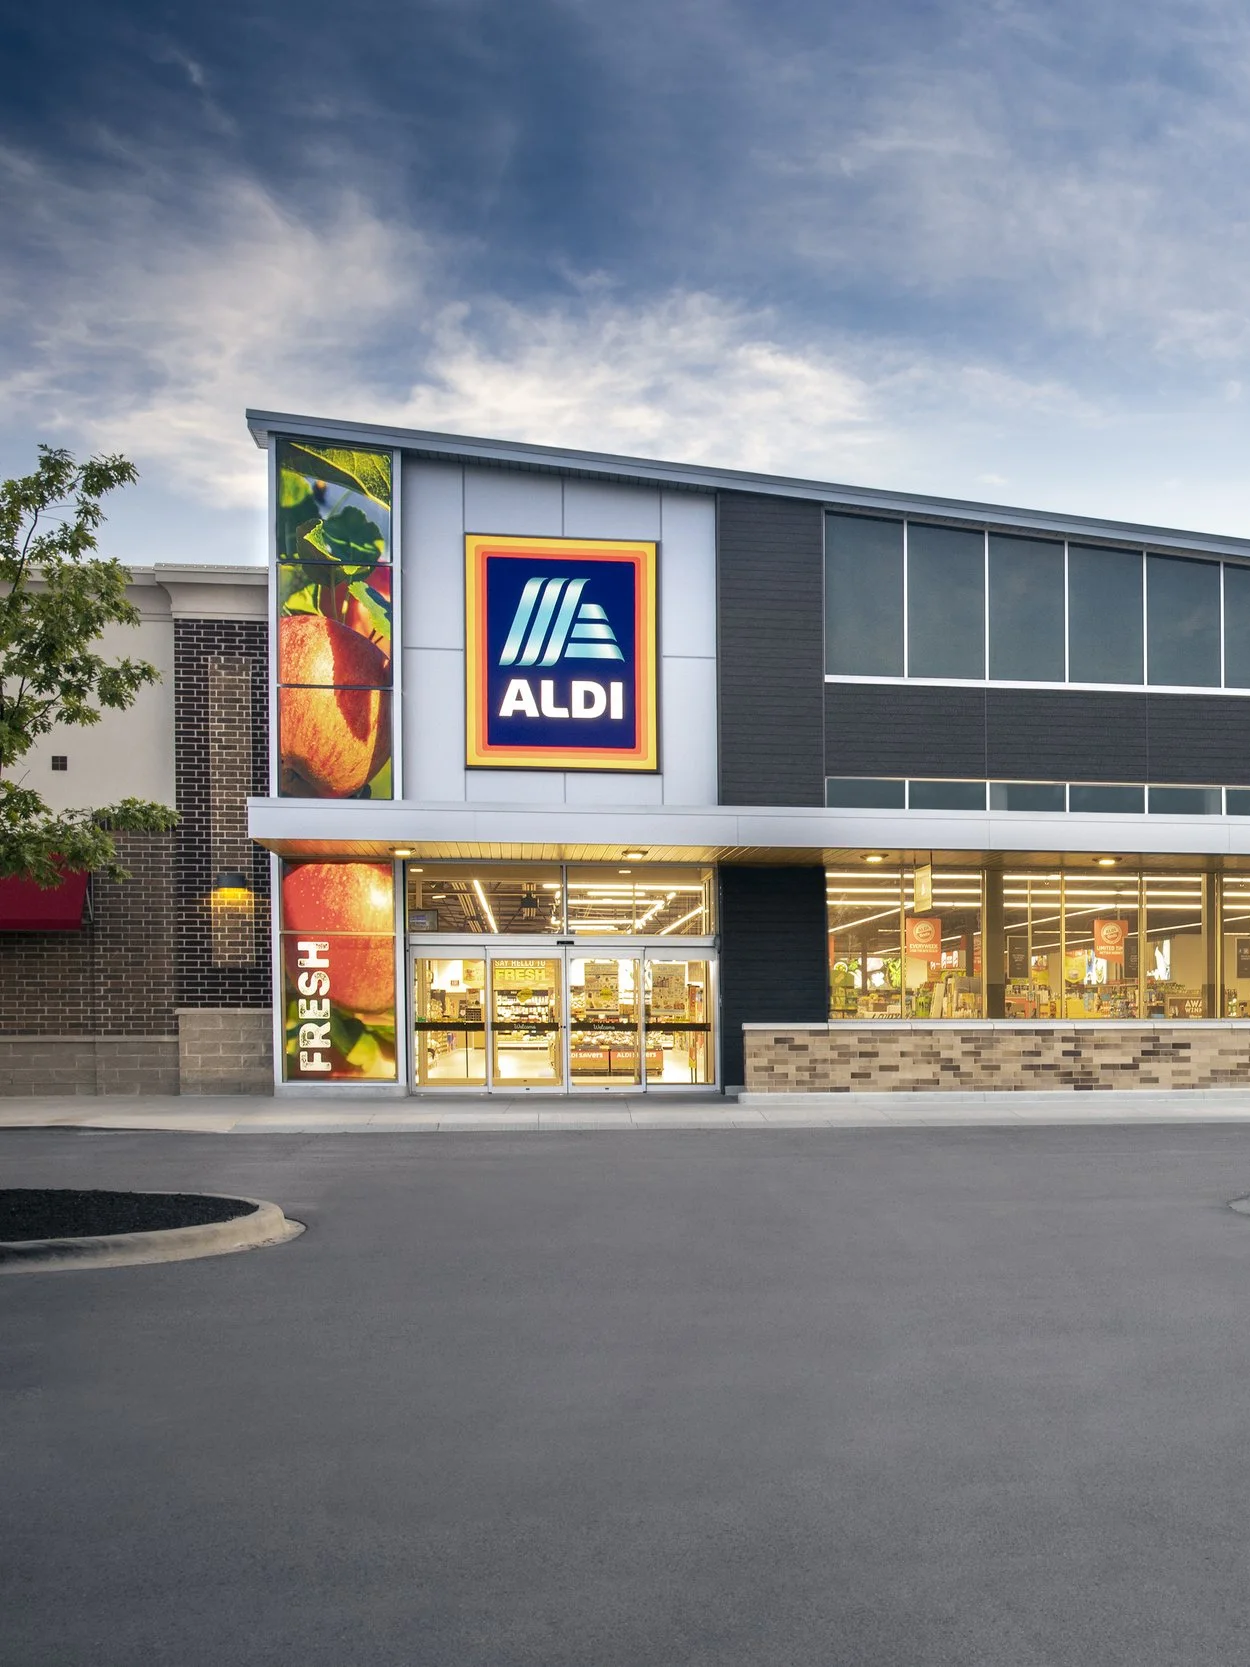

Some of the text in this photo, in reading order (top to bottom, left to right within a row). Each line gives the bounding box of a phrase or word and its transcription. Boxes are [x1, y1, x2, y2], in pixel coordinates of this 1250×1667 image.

[499, 679, 623, 719] ALDI
[495, 968, 546, 981] FRESH
[297, 941, 331, 1072] FRESH
[593, 1023, 616, 1031] Welcome
